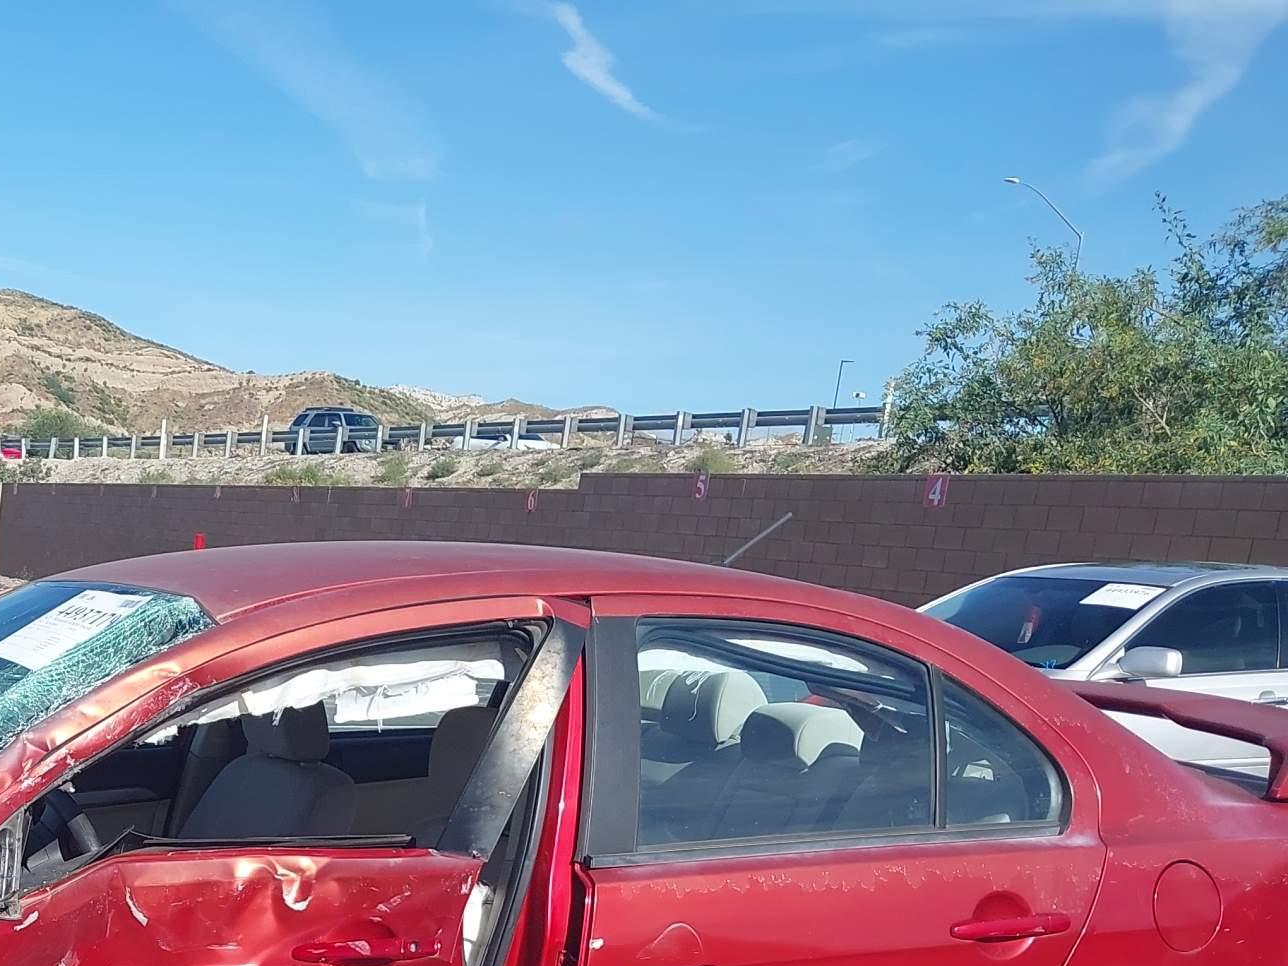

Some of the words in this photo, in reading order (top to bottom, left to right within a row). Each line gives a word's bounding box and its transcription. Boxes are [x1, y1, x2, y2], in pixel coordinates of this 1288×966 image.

[695, 474, 705, 499] 5
[927, 476, 943, 505] 4
[527, 489, 536, 511] 6
[56, 604, 122, 630] 44937179
